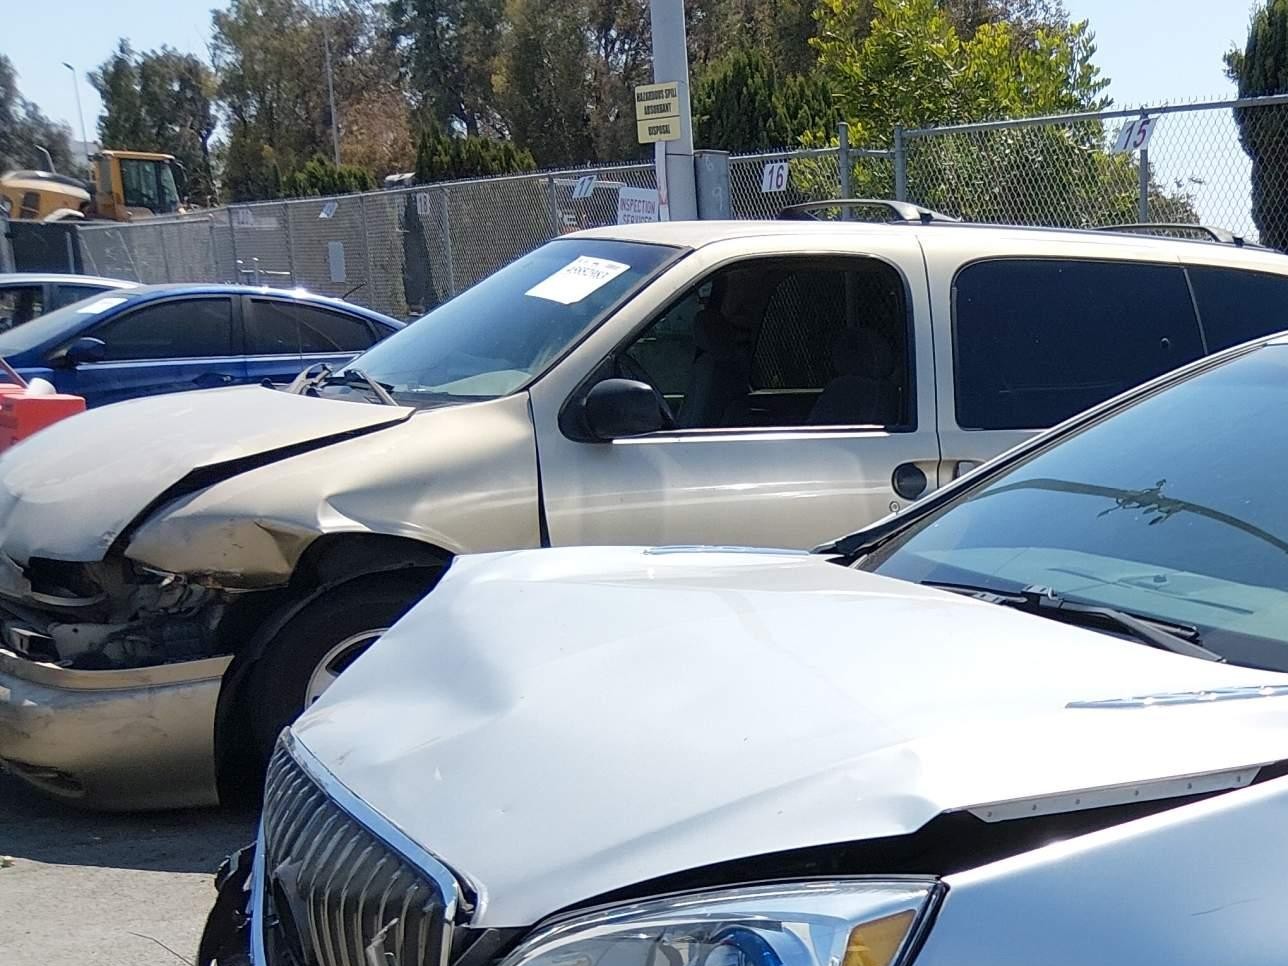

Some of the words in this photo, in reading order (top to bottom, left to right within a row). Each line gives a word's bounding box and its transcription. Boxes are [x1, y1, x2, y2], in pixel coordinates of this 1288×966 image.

[637, 90, 664, 102] HAZARDOUS
[664, 88, 677, 98] SPILL
[648, 125, 671, 136] DISPOSAL
[1123, 120, 1151, 149] 15
[579, 176, 594, 196] 17
[768, 165, 785, 190] 16
[620, 198, 656, 214] INSPECTION
